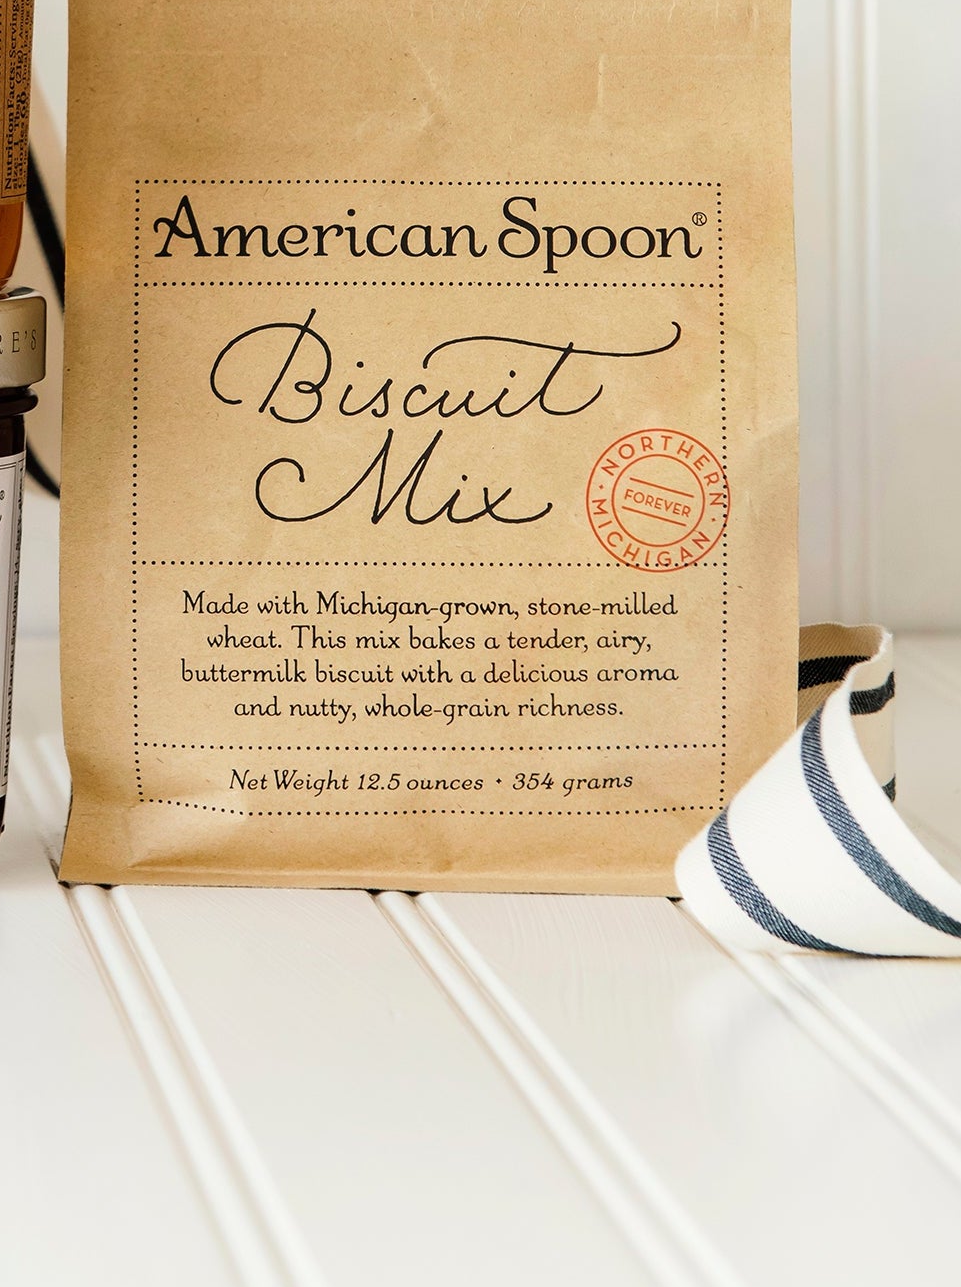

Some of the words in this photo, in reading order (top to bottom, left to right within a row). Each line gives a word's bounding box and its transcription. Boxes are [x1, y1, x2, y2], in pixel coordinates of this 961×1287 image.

[5, 112, 14, 190] Nutrition
[154, 195, 487, 257] American
[210, 308, 681, 423] Biscuit
[256, 428, 553, 525] Mix
[601, 435, 724, 506] NORTHERN
[624, 488, 692, 518] FOREVER
[592, 499, 711, 567] MICHIGAN
[183, 590, 248, 614] Made
[257, 591, 308, 614] with
[317, 591, 519, 623] Michigan-grown,
[528, 592, 678, 615] stone-milled
[207, 625, 281, 648] wheat.
[291, 625, 346, 648] This
[356, 631, 400, 648] mix
[409, 625, 475, 649] bakes
[485, 637, 500, 649] a
[507, 628, 588, 652] tender,
[597, 630, 651, 655] airy,
[181, 658, 306, 682] buttermilk
[315, 659, 393, 682] biscuit
[402, 660, 453, 683] with
[461, 671, 476, 683] a
[484, 659, 588, 683] delicious
[597, 669, 679, 681] aroma
[235, 696, 281, 716] and
[290, 699, 356, 724] nutty,
[365, 693, 509, 725] whole-grain
[518, 693, 623, 716] richness.
[230, 769, 267, 790] Net
[274, 770, 348, 797] Weight
[358, 774, 400, 790] 12.5
[407, 779, 483, 790] ounces
[513, 773, 554, 790] 354
[563, 777, 633, 795] grams
